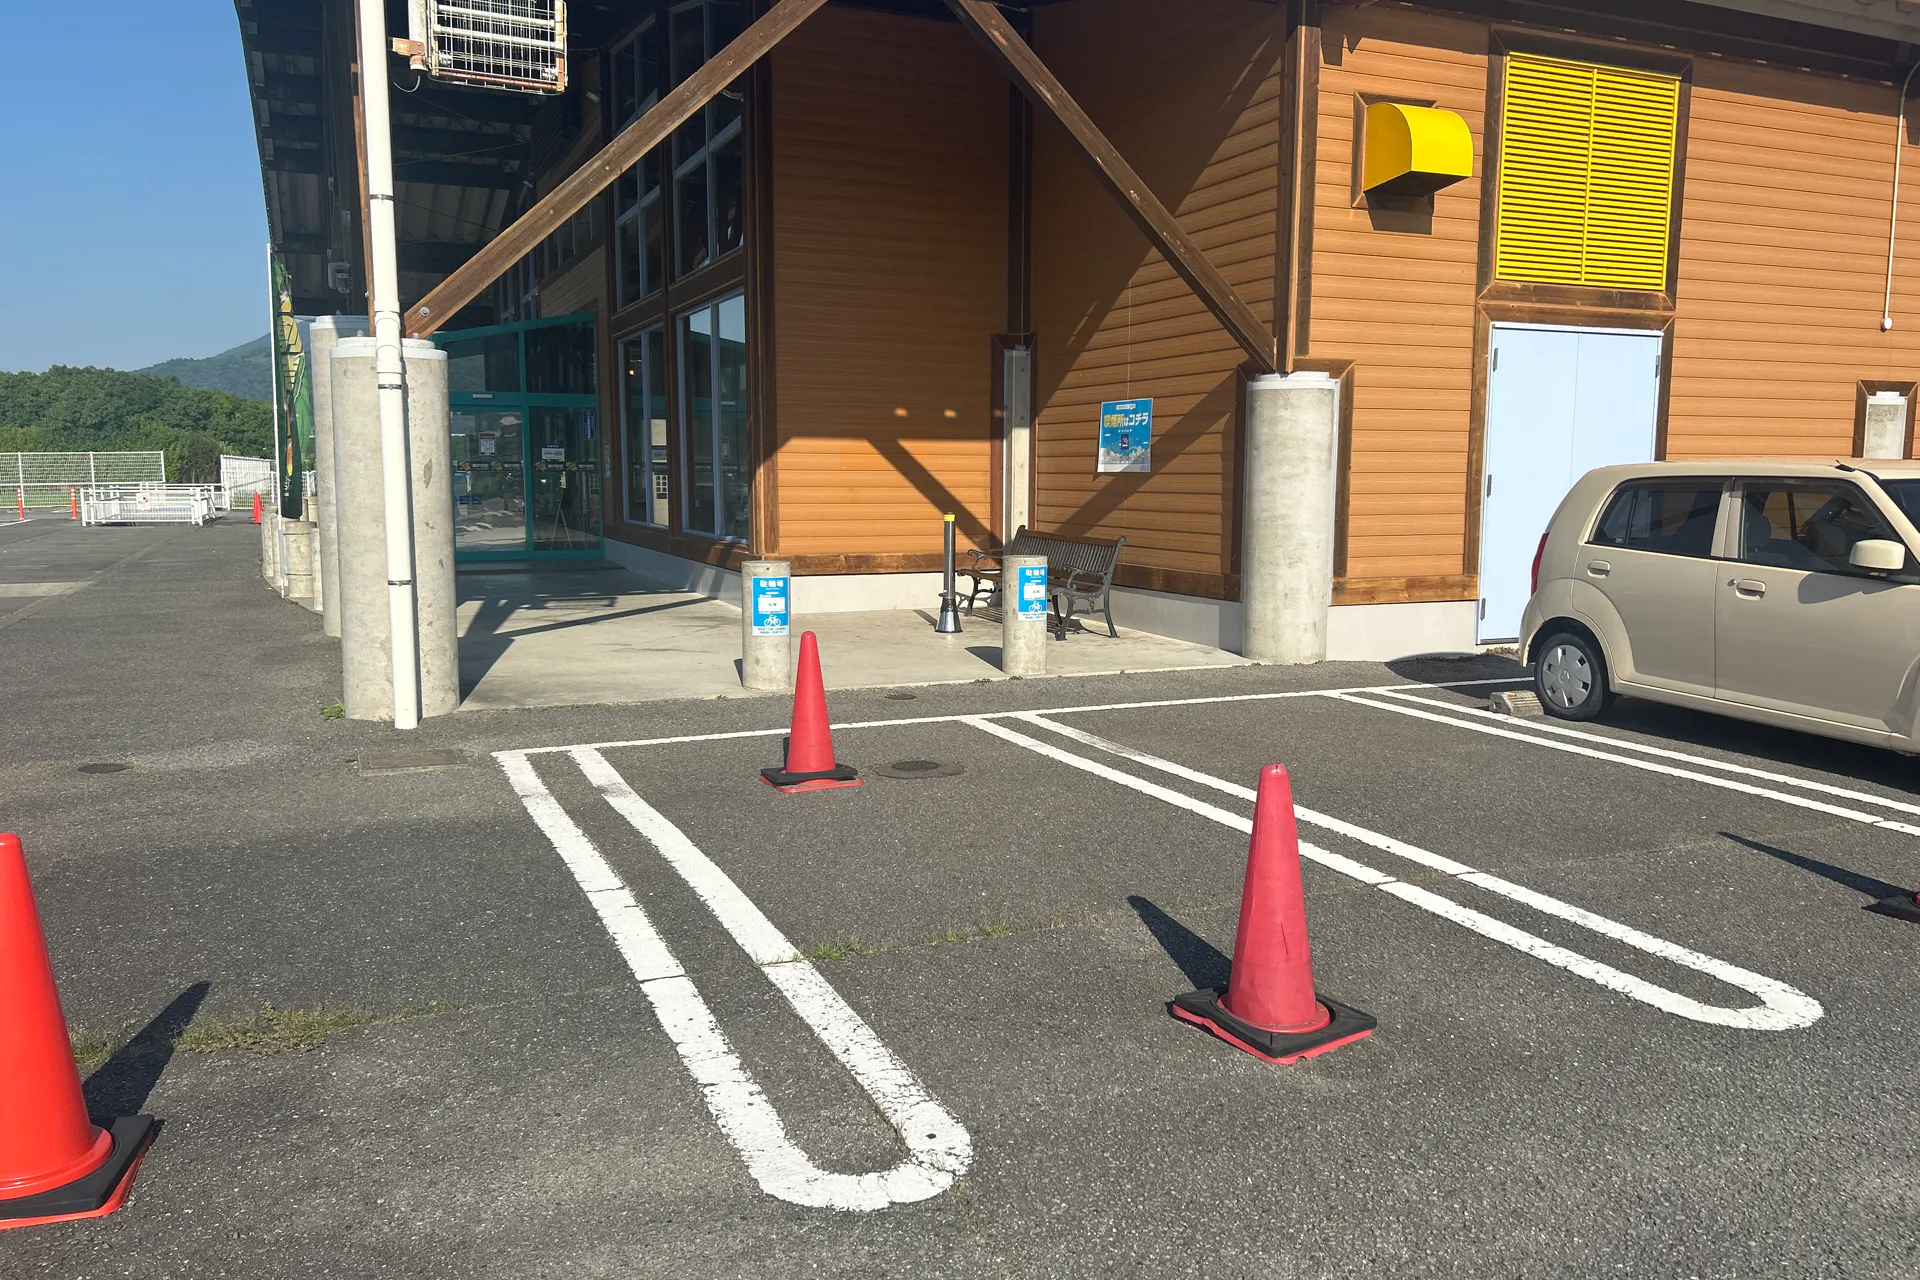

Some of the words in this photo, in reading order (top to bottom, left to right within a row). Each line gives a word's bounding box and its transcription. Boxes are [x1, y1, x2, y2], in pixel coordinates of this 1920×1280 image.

[1104, 412, 1149, 428] 喫煙所はコチラ
